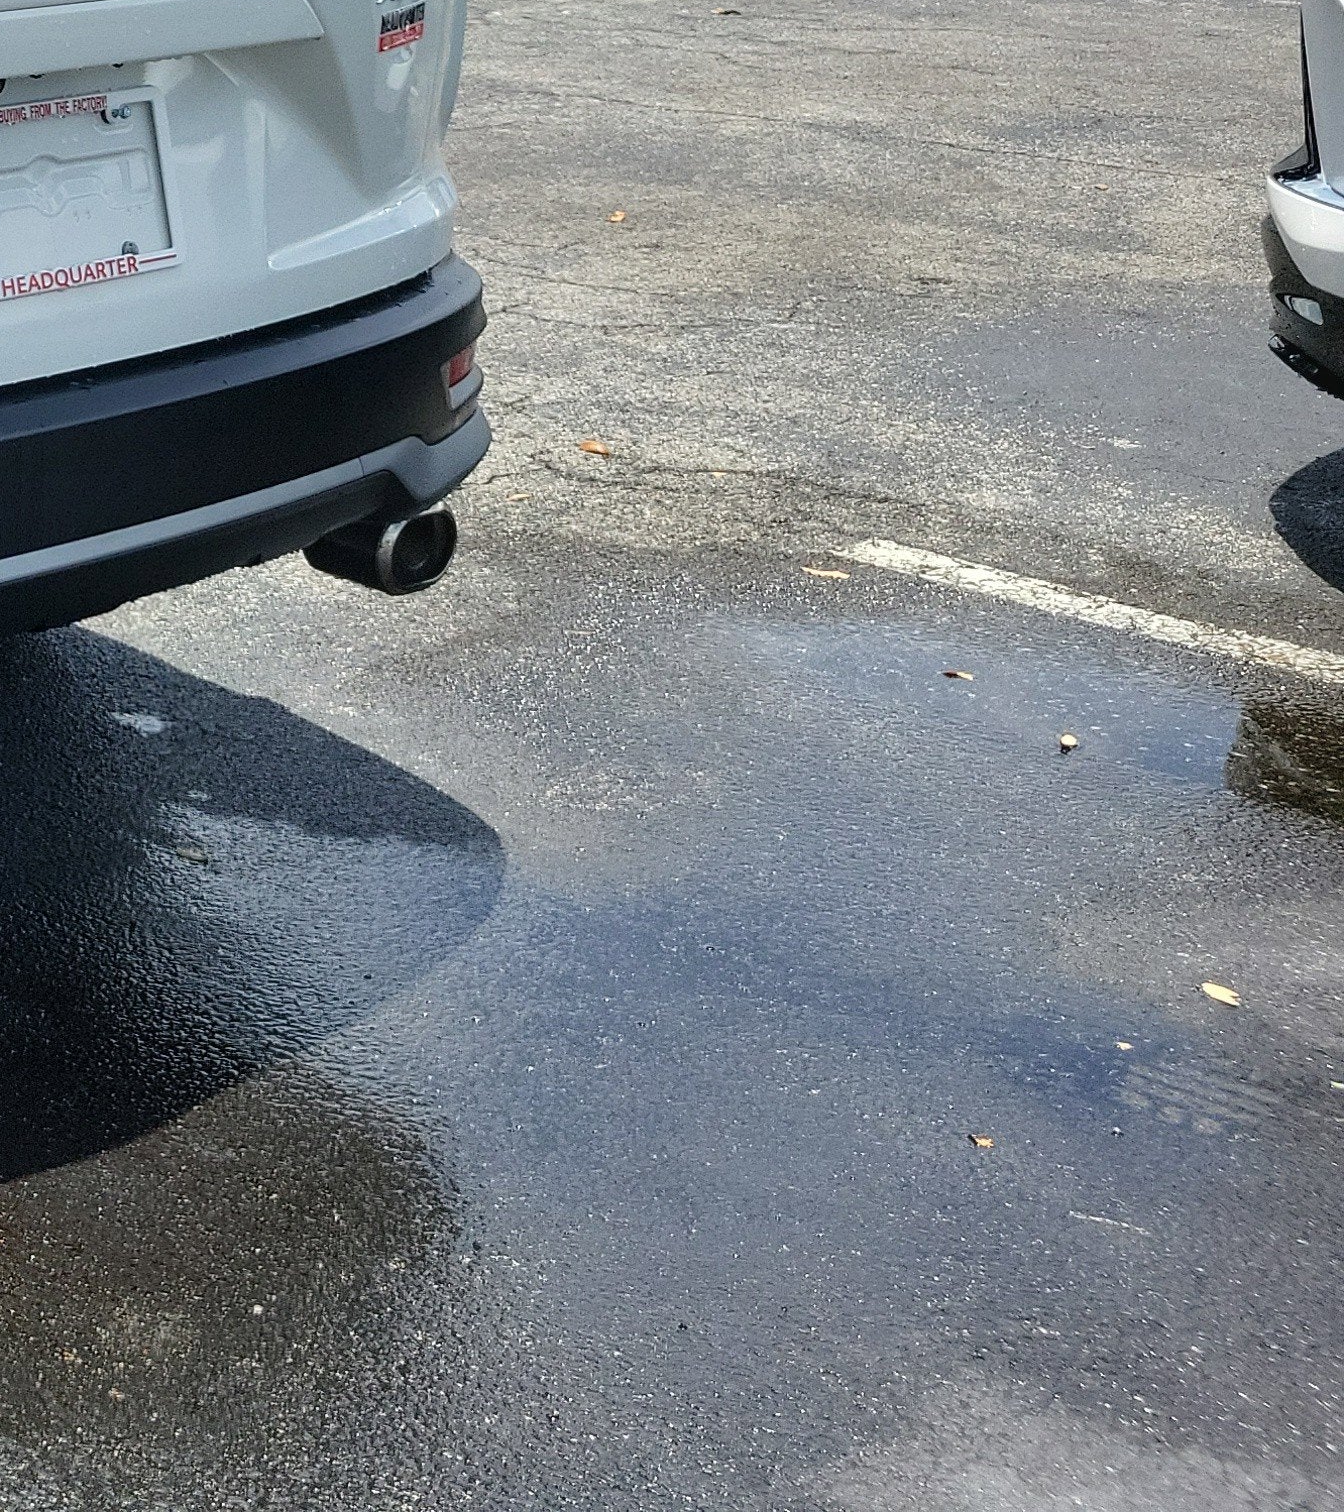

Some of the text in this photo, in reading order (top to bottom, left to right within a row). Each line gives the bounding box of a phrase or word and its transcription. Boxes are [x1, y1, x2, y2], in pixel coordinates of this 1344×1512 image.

[30, 103, 52, 118] FROM
[55, 100, 70, 114] THE
[1, 256, 139, 297] HEADQUARTER
